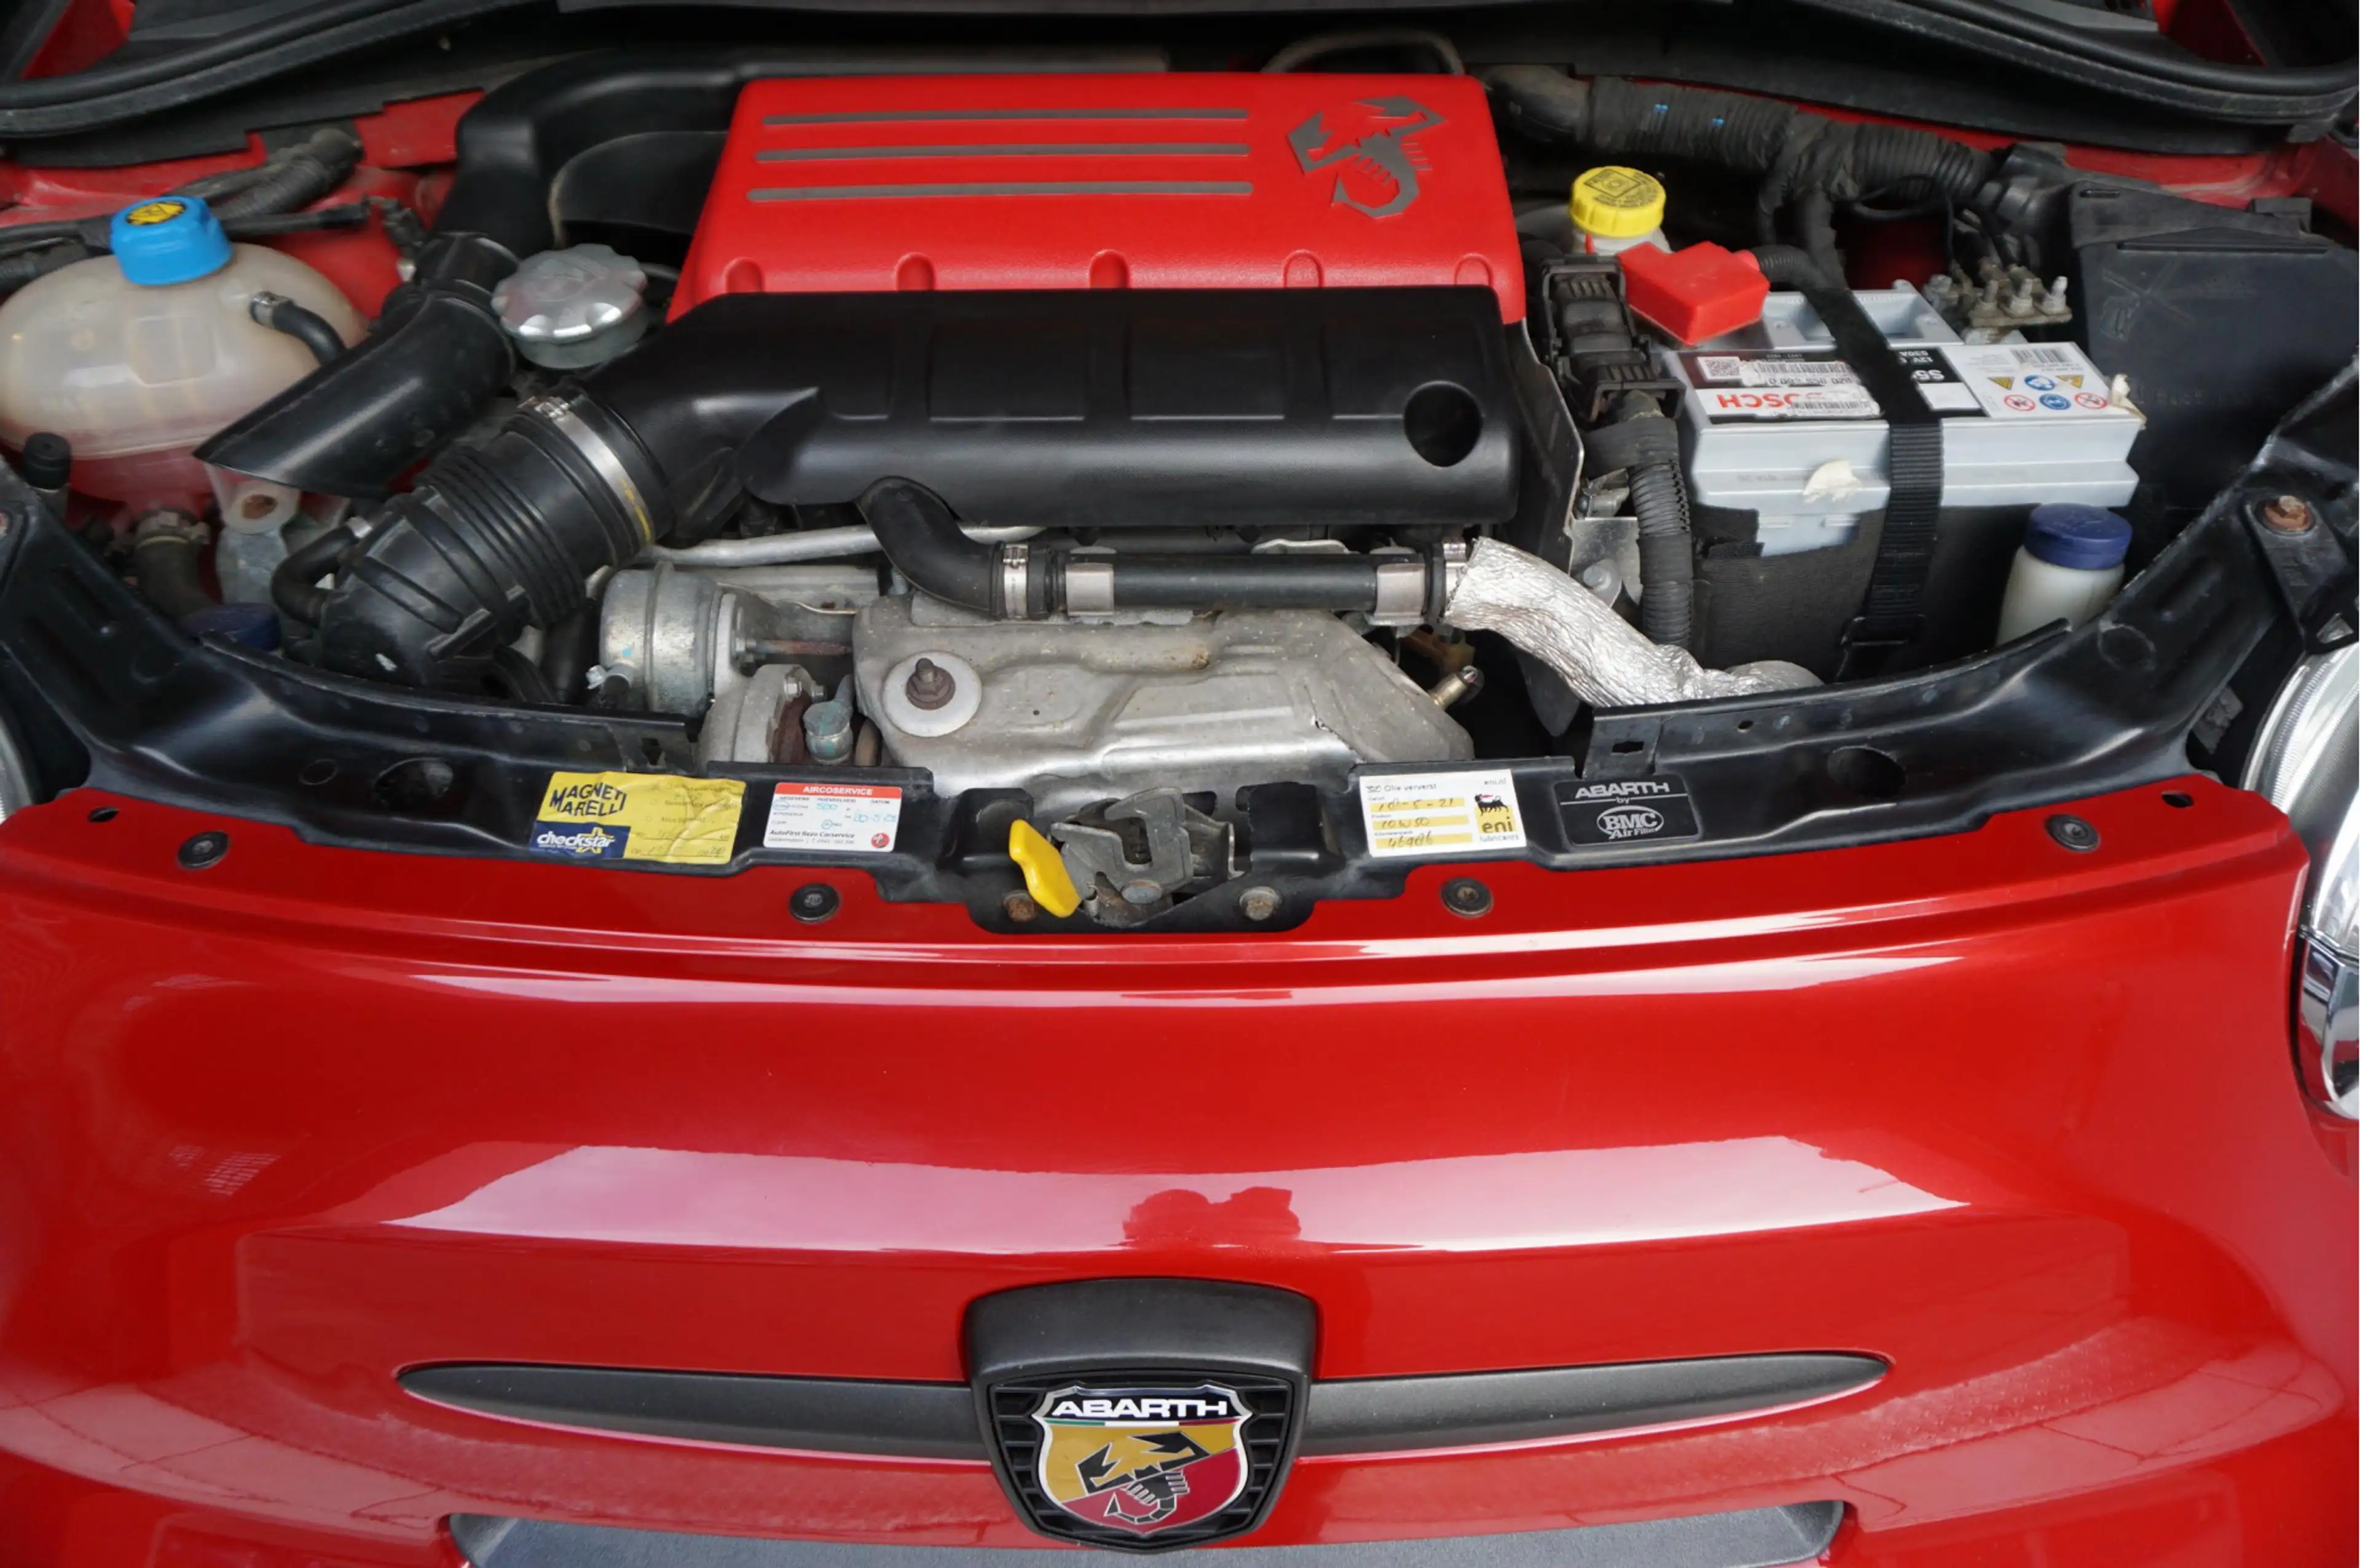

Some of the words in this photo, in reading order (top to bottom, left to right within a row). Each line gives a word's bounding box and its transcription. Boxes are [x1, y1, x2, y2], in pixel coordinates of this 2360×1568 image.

[1717, 393, 1823, 408] OSCH
[550, 782, 627, 808] MAGNETI
[803, 786, 873, 796] AIRCOSERVICE
[1575, 782, 1670, 799] ABARTH
[550, 790, 627, 817] MARELLI
[1482, 817, 1513, 834] eni
[1603, 812, 1658, 830] BMC
[537, 831, 615, 848] checkstar
[1608, 829, 1633, 839] Air
[1052, 1398, 1227, 1417] ABARTH
